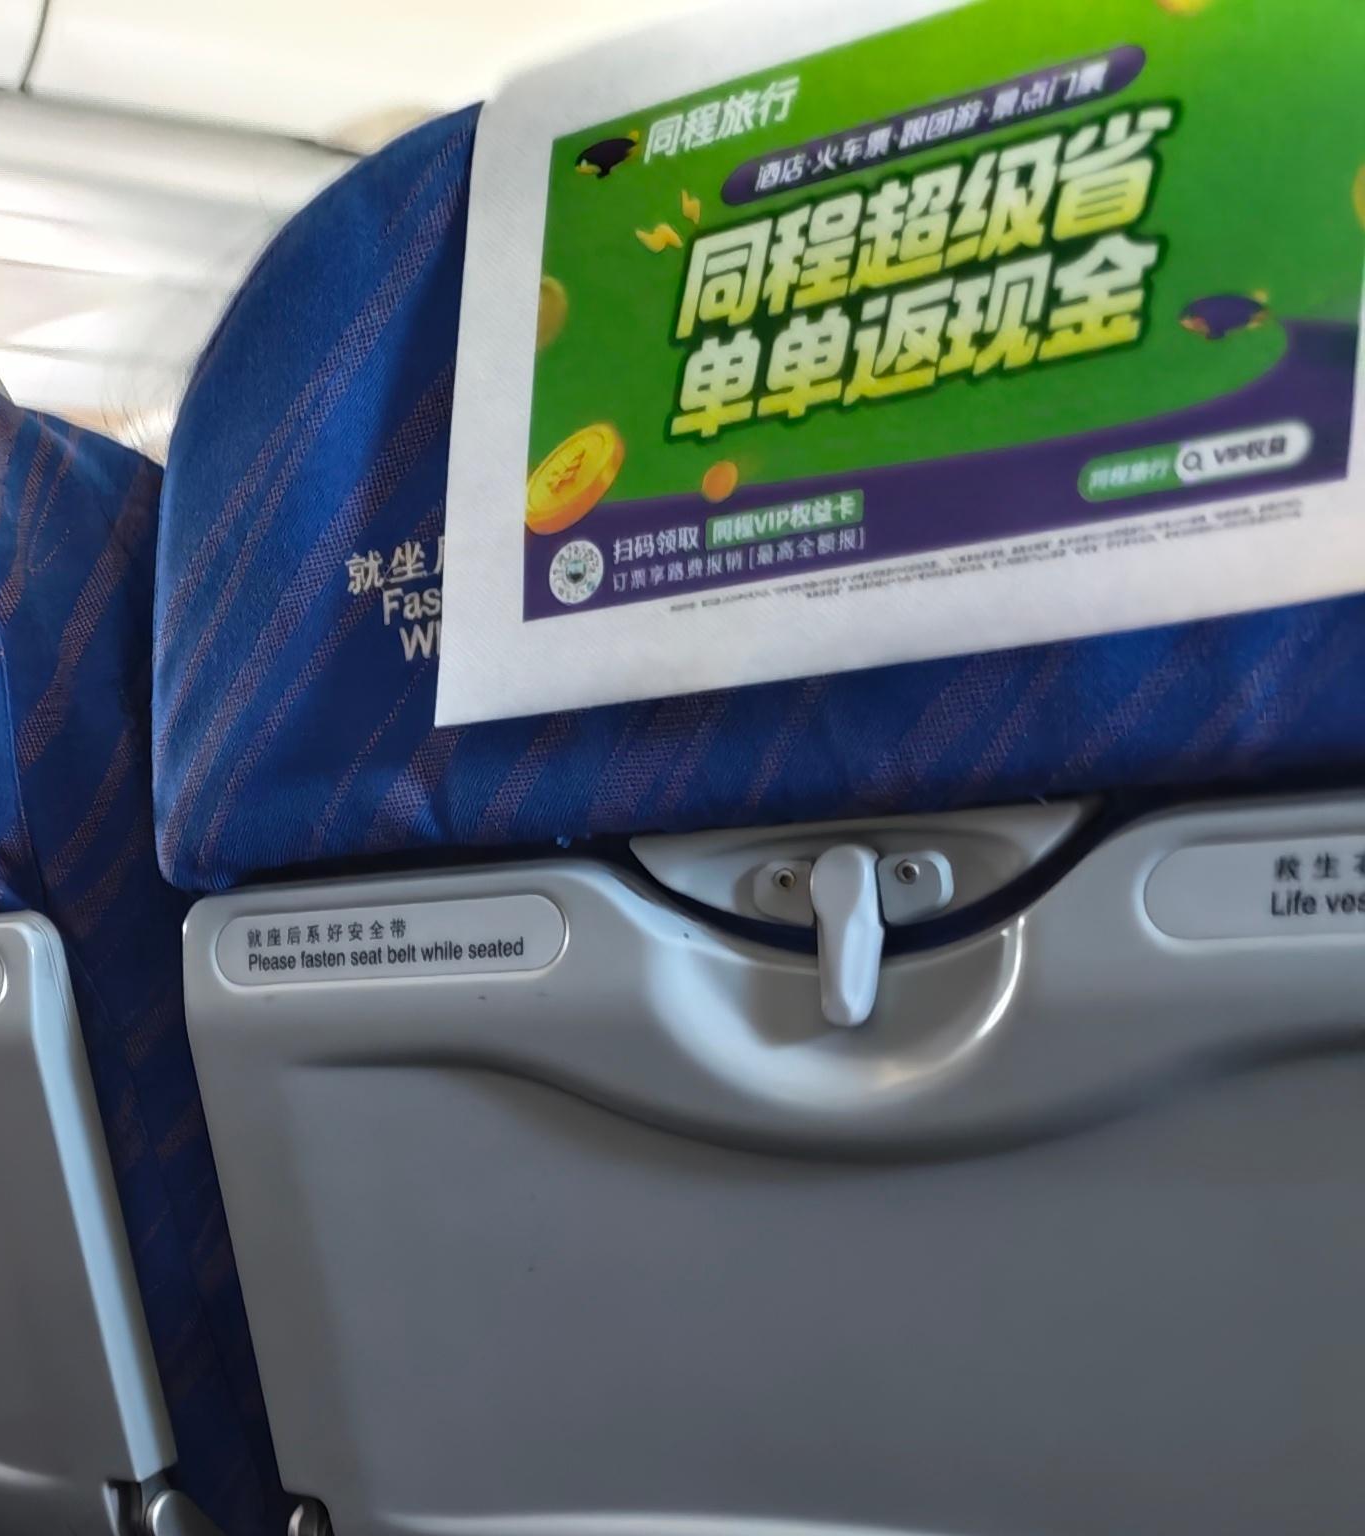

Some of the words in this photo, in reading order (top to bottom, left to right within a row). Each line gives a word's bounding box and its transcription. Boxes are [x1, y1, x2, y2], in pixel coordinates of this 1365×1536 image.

[644, 75, 800, 164] 同程旅行
[674, 106, 1174, 339] 同程超级省
[670, 232, 1160, 437] 单单返现金
[612, 526, 700, 565] 扫码领取
[398, 619, 442, 661] W
[1271, 889, 1317, 917] Life
[247, 918, 407, 949] 就座后系好安全带
[248, 952, 297, 972] Please
[300, 949, 346, 969] fasten
[350, 946, 383, 966] seat
[387, 943, 417, 964] belt
[421, 940, 463, 962] while
[468, 935, 524, 960] seated
